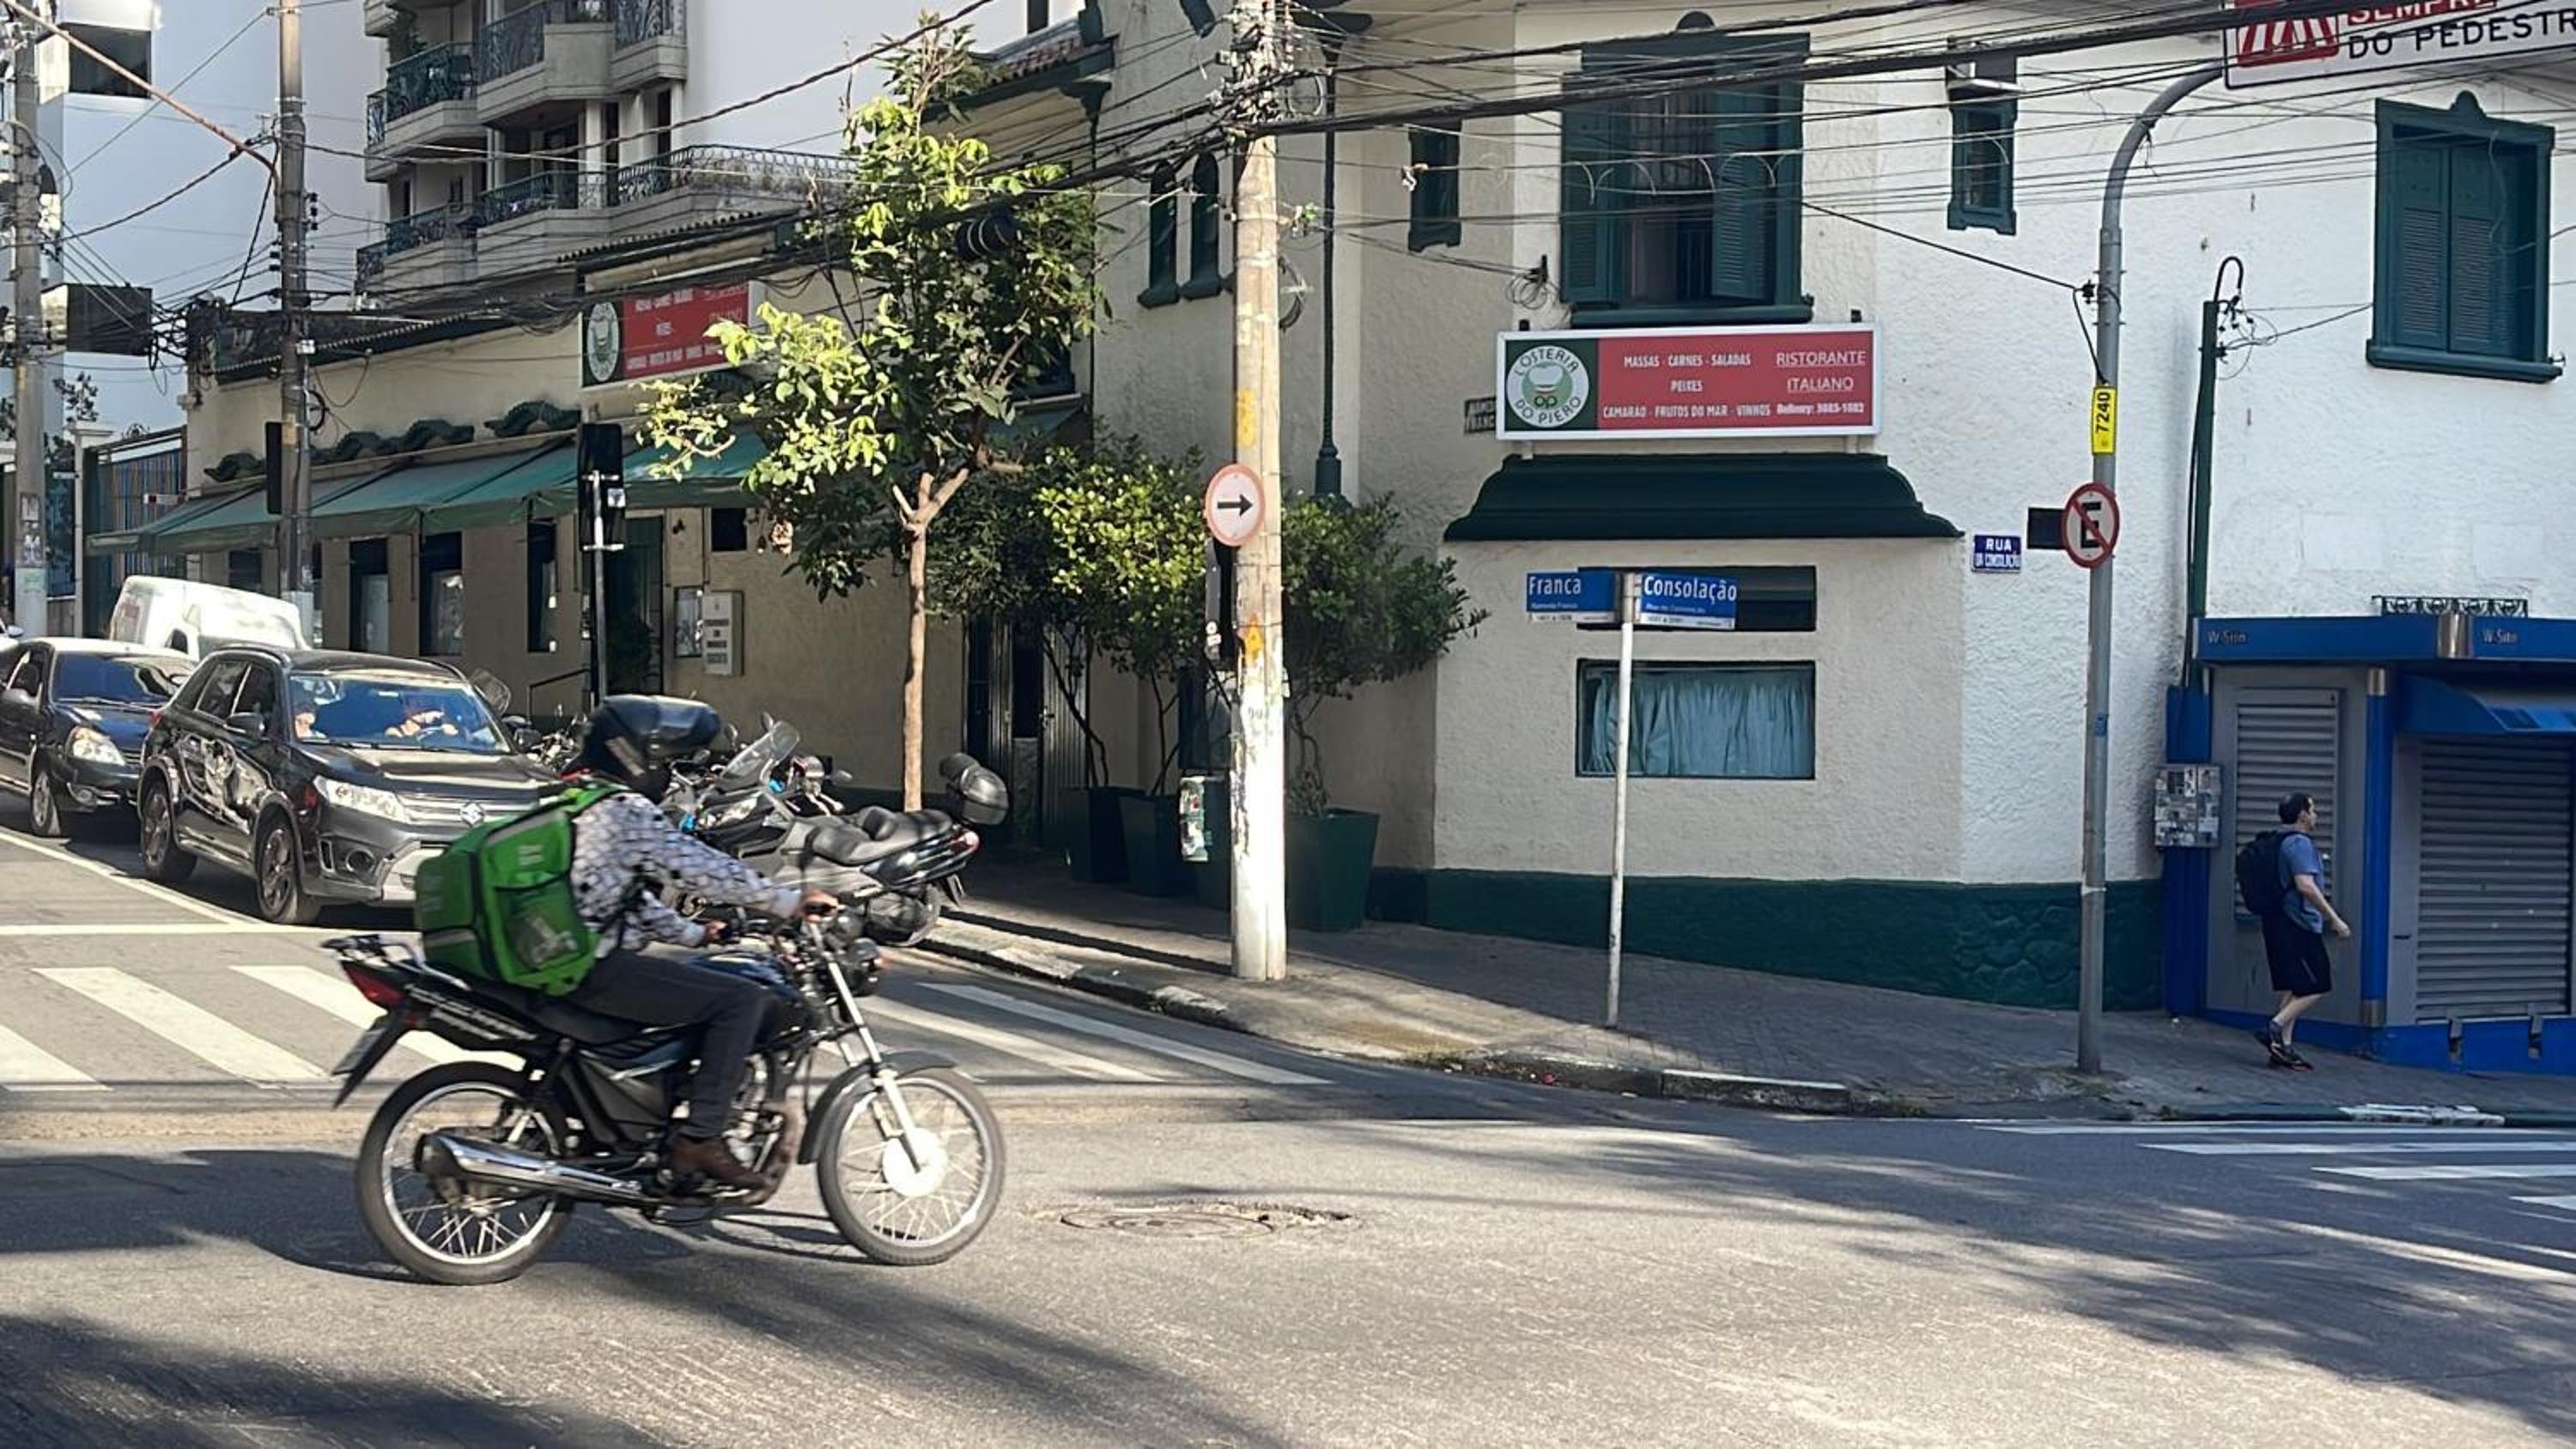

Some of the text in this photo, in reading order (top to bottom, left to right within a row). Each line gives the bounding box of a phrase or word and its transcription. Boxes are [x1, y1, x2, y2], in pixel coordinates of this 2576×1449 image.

[2349, 9, 2576, 58] DO PEDESTR
[1624, 355, 1660, 367] MASSAS
[1711, 353, 1752, 366] SALADAS
[1776, 350, 1867, 367] RISTORANTE
[1787, 376, 1855, 393] ITALIANO
[1514, 396, 1581, 423] DO PIERO
[2095, 391, 2111, 433] 7240
[1986, 538, 2012, 551] RUA
[1528, 576, 1582, 596] Franca
[1644, 576, 1737, 605] Consolação
